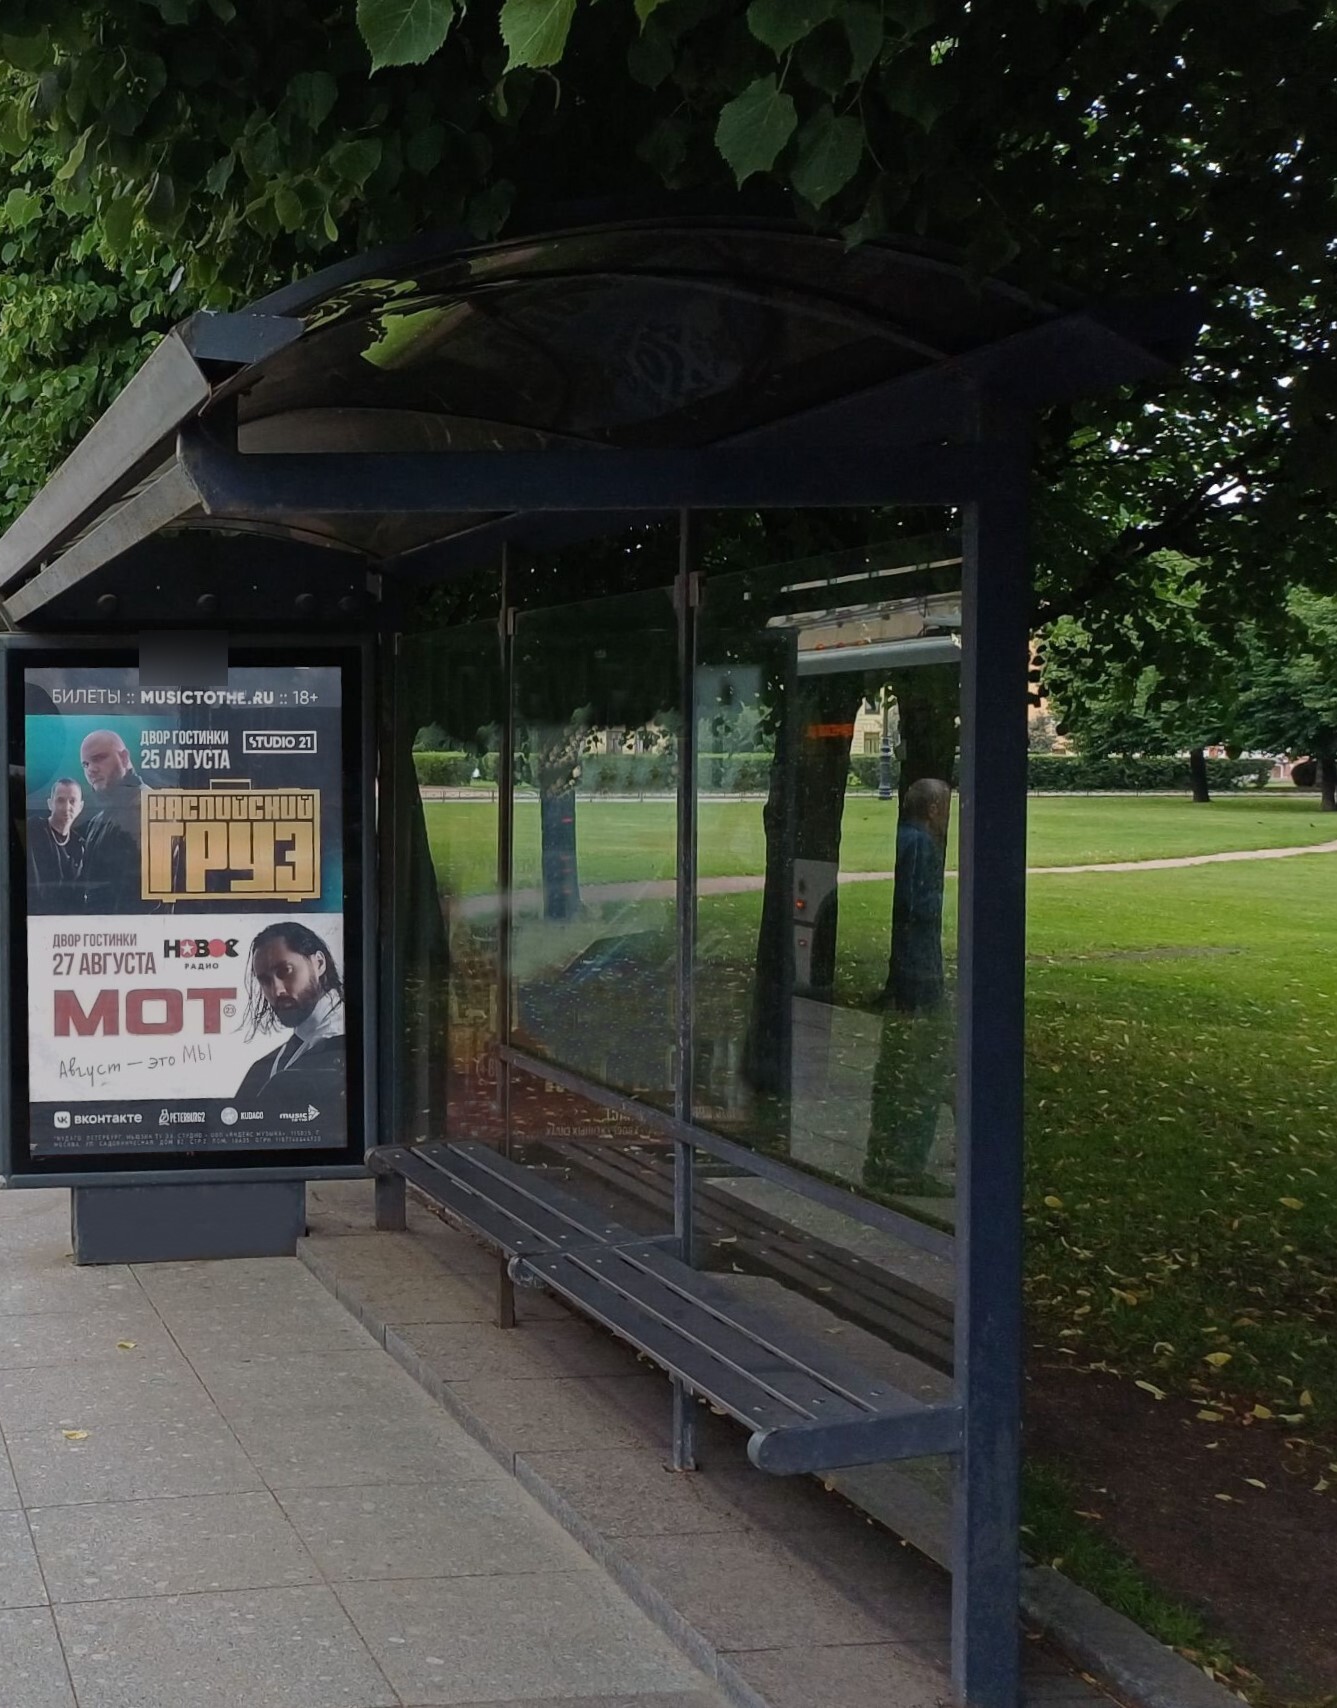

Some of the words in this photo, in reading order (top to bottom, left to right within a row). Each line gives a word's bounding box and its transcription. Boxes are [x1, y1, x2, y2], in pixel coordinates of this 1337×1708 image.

[52, 688, 121, 704] БИЛЕТЫ
[140, 690, 274, 705] MUSICTOTHE.RU
[293, 690, 319, 704] 18+
[140, 730, 171, 746] ДВОР
[172, 729, 229, 745] ГОСТИНКИ
[248, 736, 295, 748] STUDIO
[299, 736, 311, 748] 21
[140, 749, 160, 769] 25
[163, 749, 231, 769] АВГУСТА
[149, 795, 313, 820] КАСПИЙСКИЙ
[149, 821, 313, 892] ГРУЗ
[52, 933, 81, 949] ДВОР
[83, 933, 137, 948] ГОСТИНКИ
[52, 952, 75, 976] 27
[79, 951, 157, 976] АВГУСТА
[184, 962, 219, 970] РАДИО
[53, 987, 237, 1037] МОТ
[58, 1056, 121, 1087] Август
[147, 1056, 176, 1070] это
[182, 1043, 212, 1064] МЫ
[240, 1111, 264, 1120] KUDAGO
